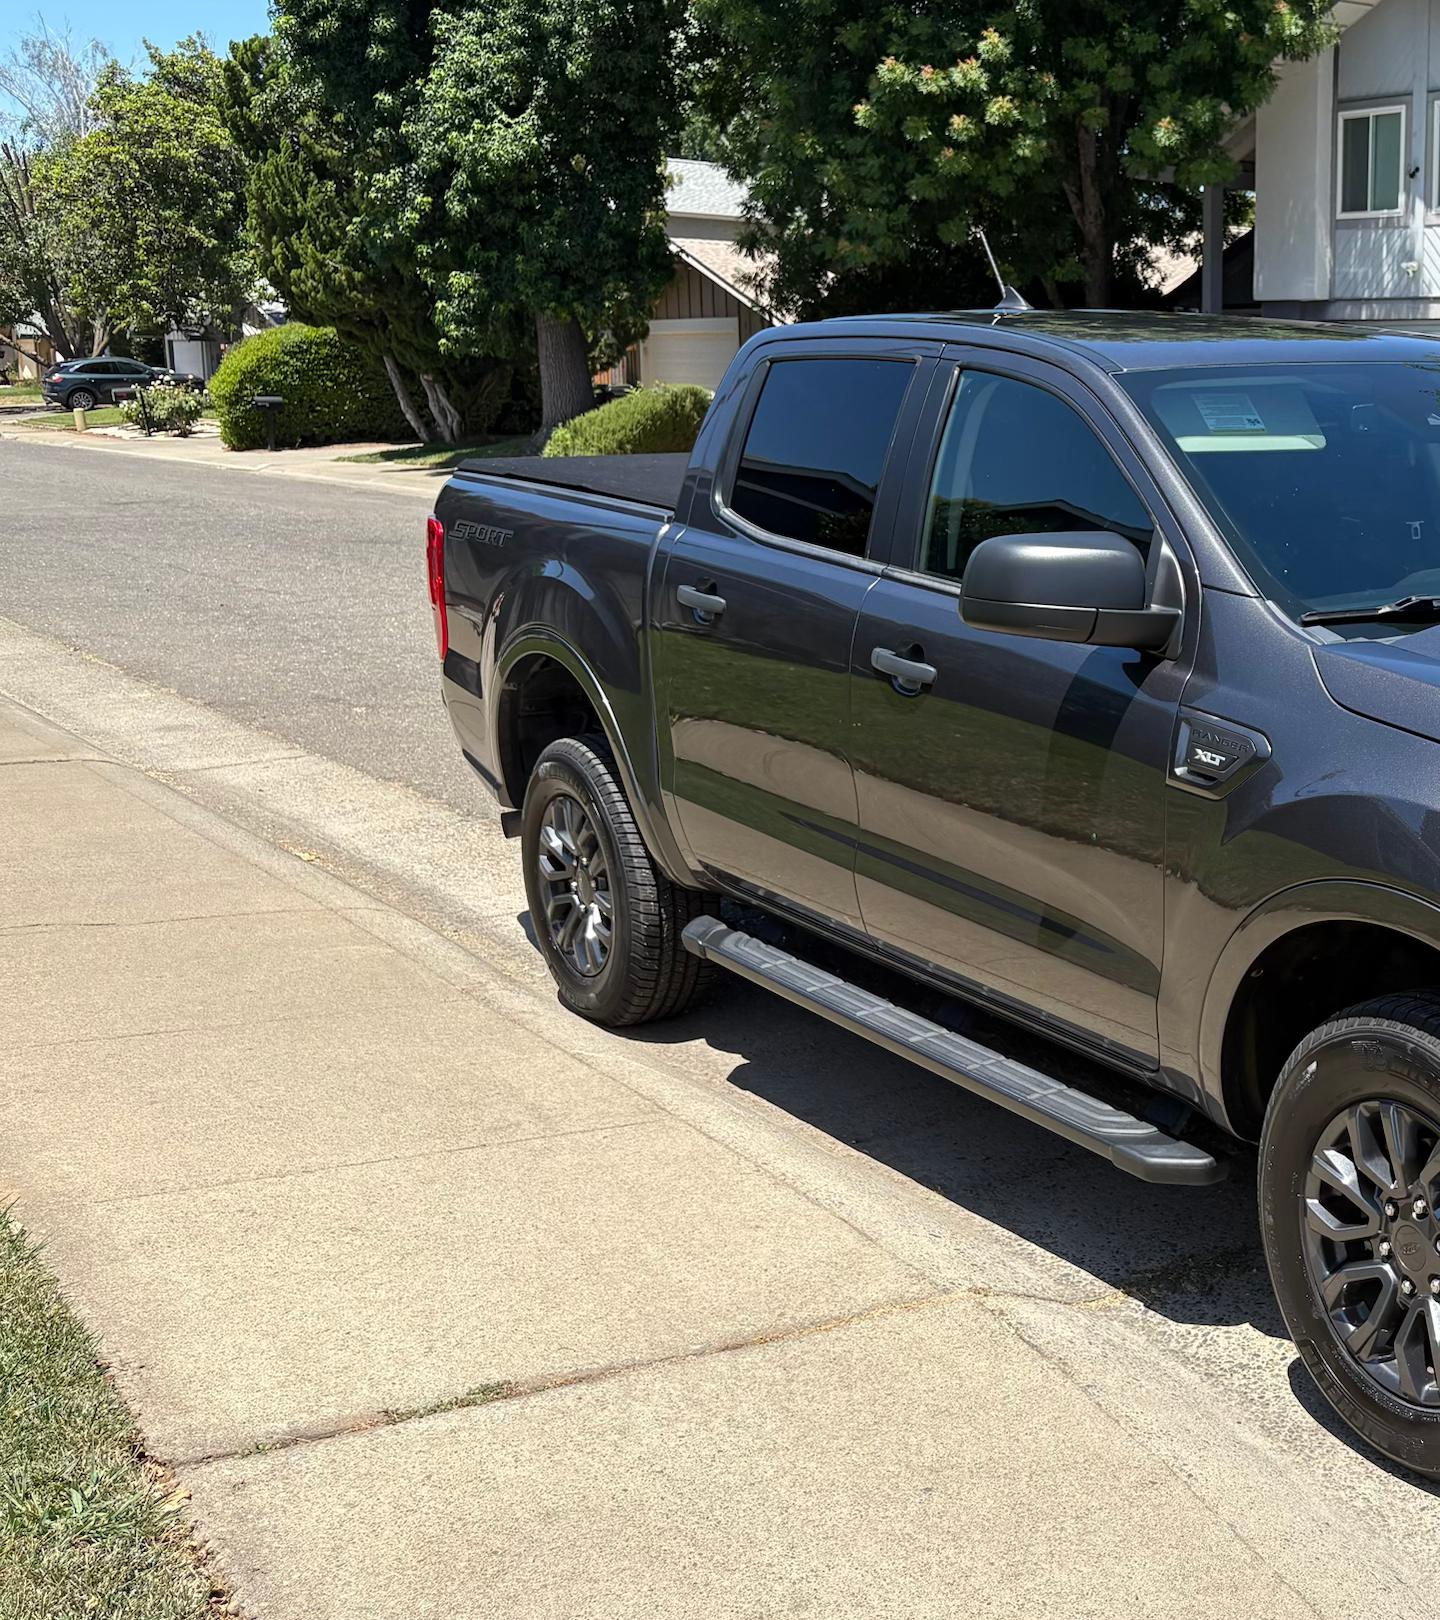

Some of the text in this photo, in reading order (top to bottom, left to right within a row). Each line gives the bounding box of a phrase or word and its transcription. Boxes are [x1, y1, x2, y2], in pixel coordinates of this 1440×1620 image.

[448, 519, 514, 548] SPORT
[1192, 728, 1251, 753] RANGER
[1193, 748, 1226, 767] XLT
